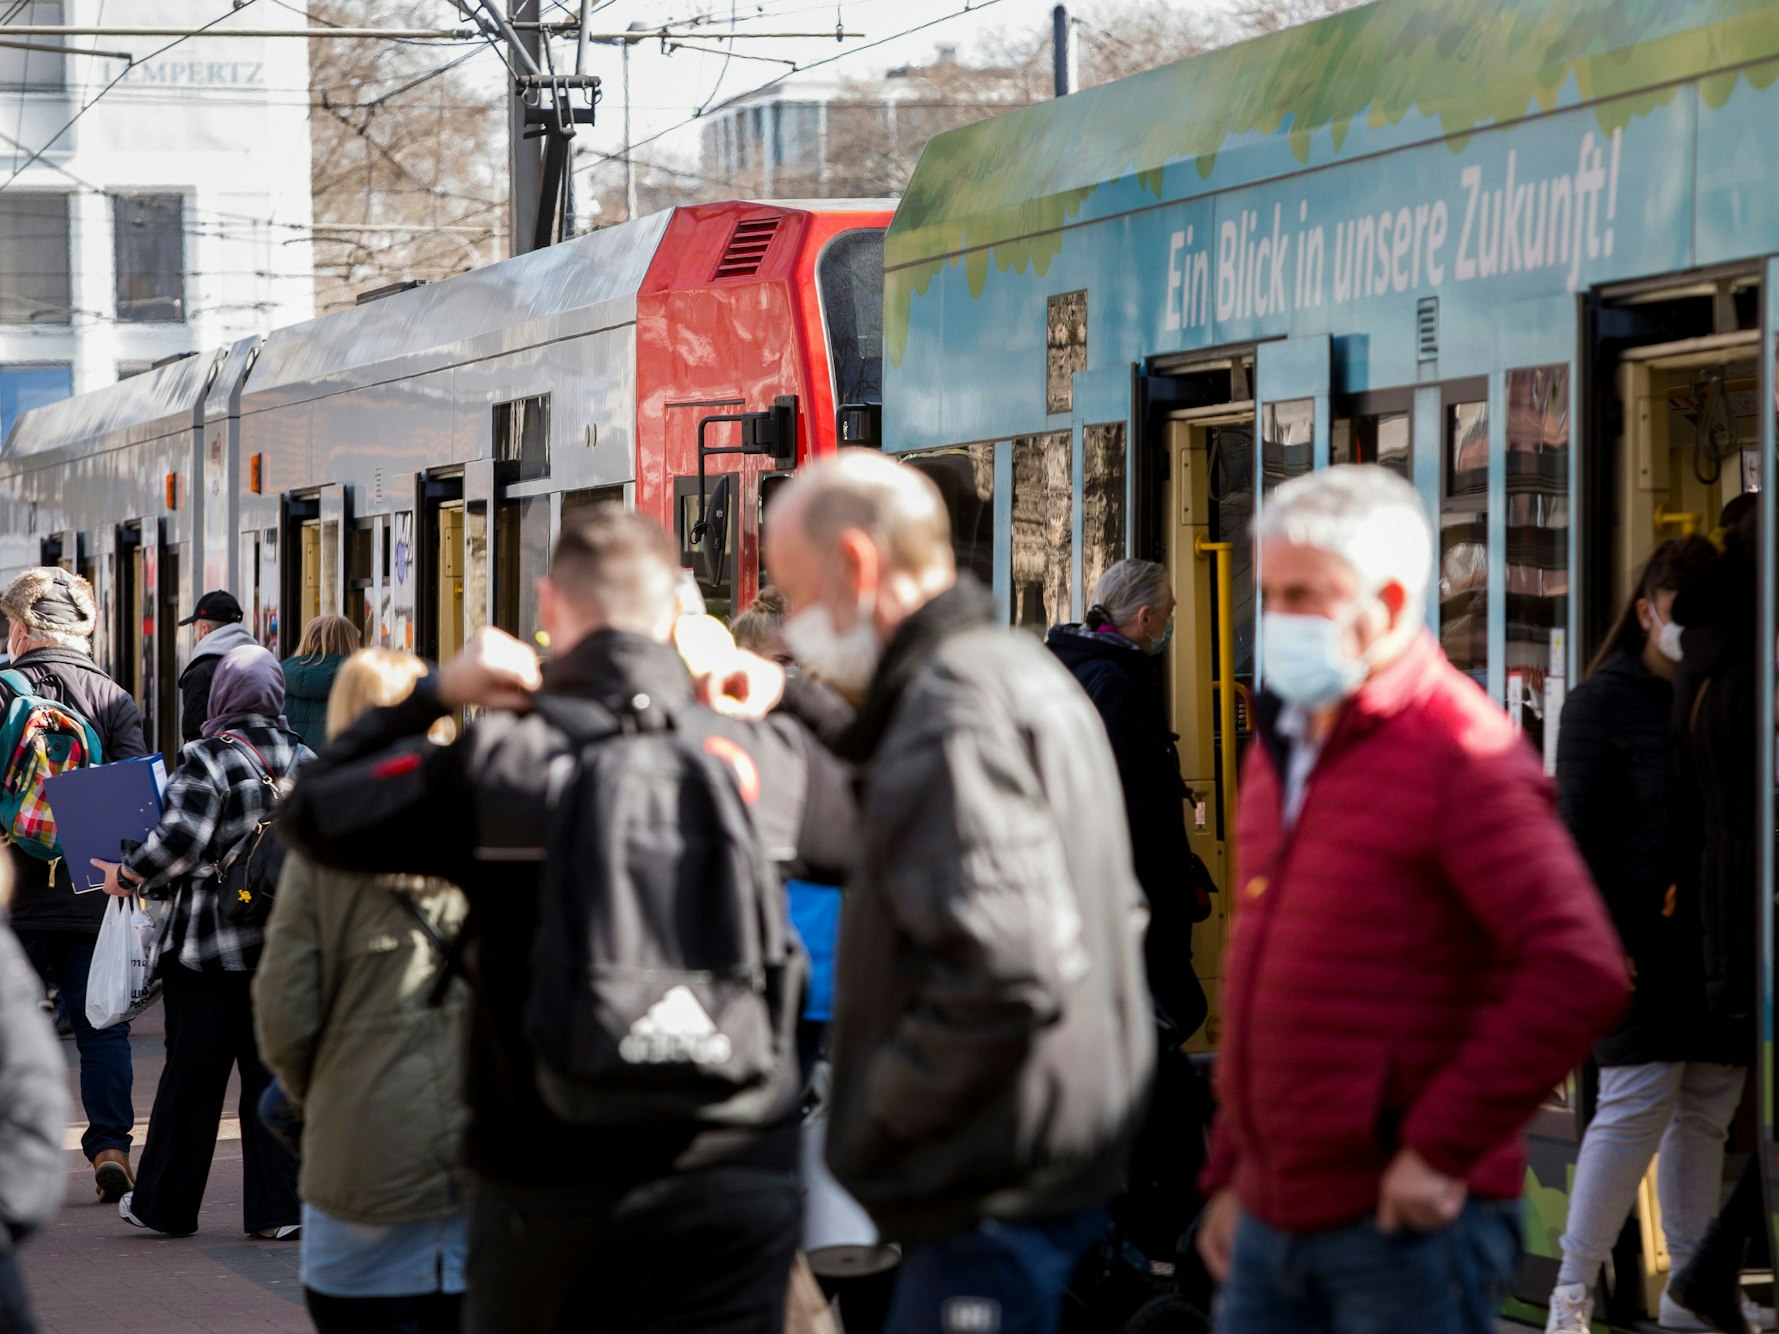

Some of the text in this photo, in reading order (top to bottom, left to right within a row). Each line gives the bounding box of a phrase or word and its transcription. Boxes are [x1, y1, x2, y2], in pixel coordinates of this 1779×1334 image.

[1165, 126, 1622, 331] Ein Blick in unsere Zukunft!
